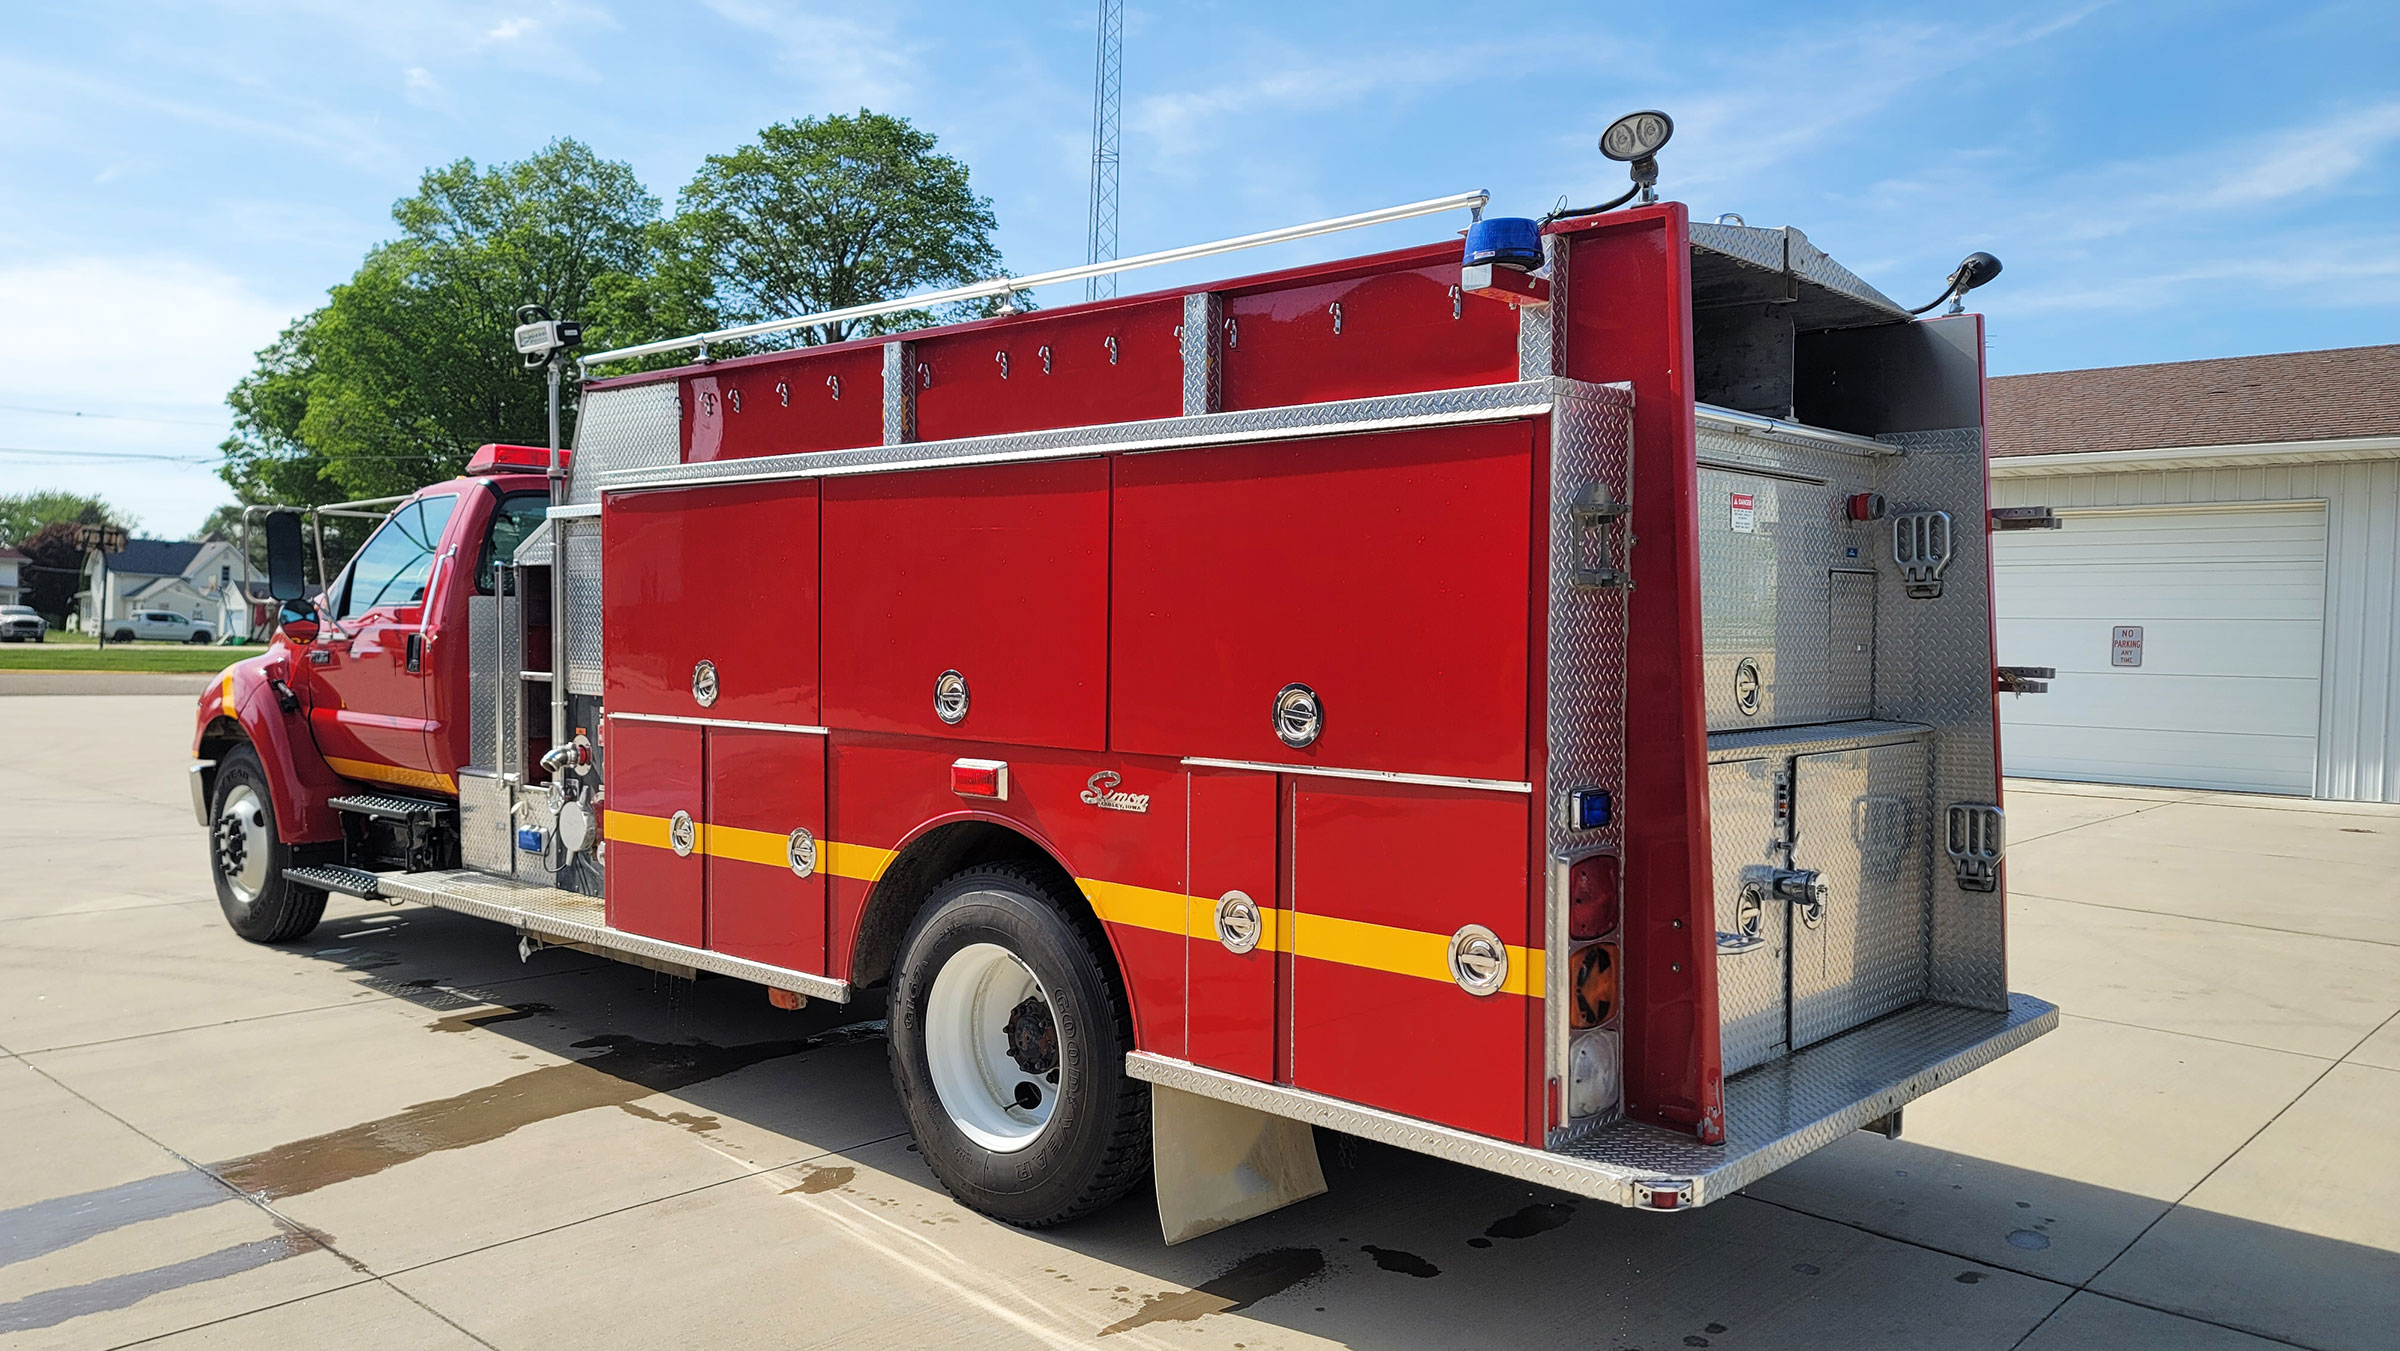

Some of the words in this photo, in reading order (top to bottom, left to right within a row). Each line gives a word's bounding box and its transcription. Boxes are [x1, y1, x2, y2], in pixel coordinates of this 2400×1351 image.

[2121, 629, 2134, 638] NO
[2114, 639, 2141, 648] PARKING
[1080, 770, 1150, 806] Simon
